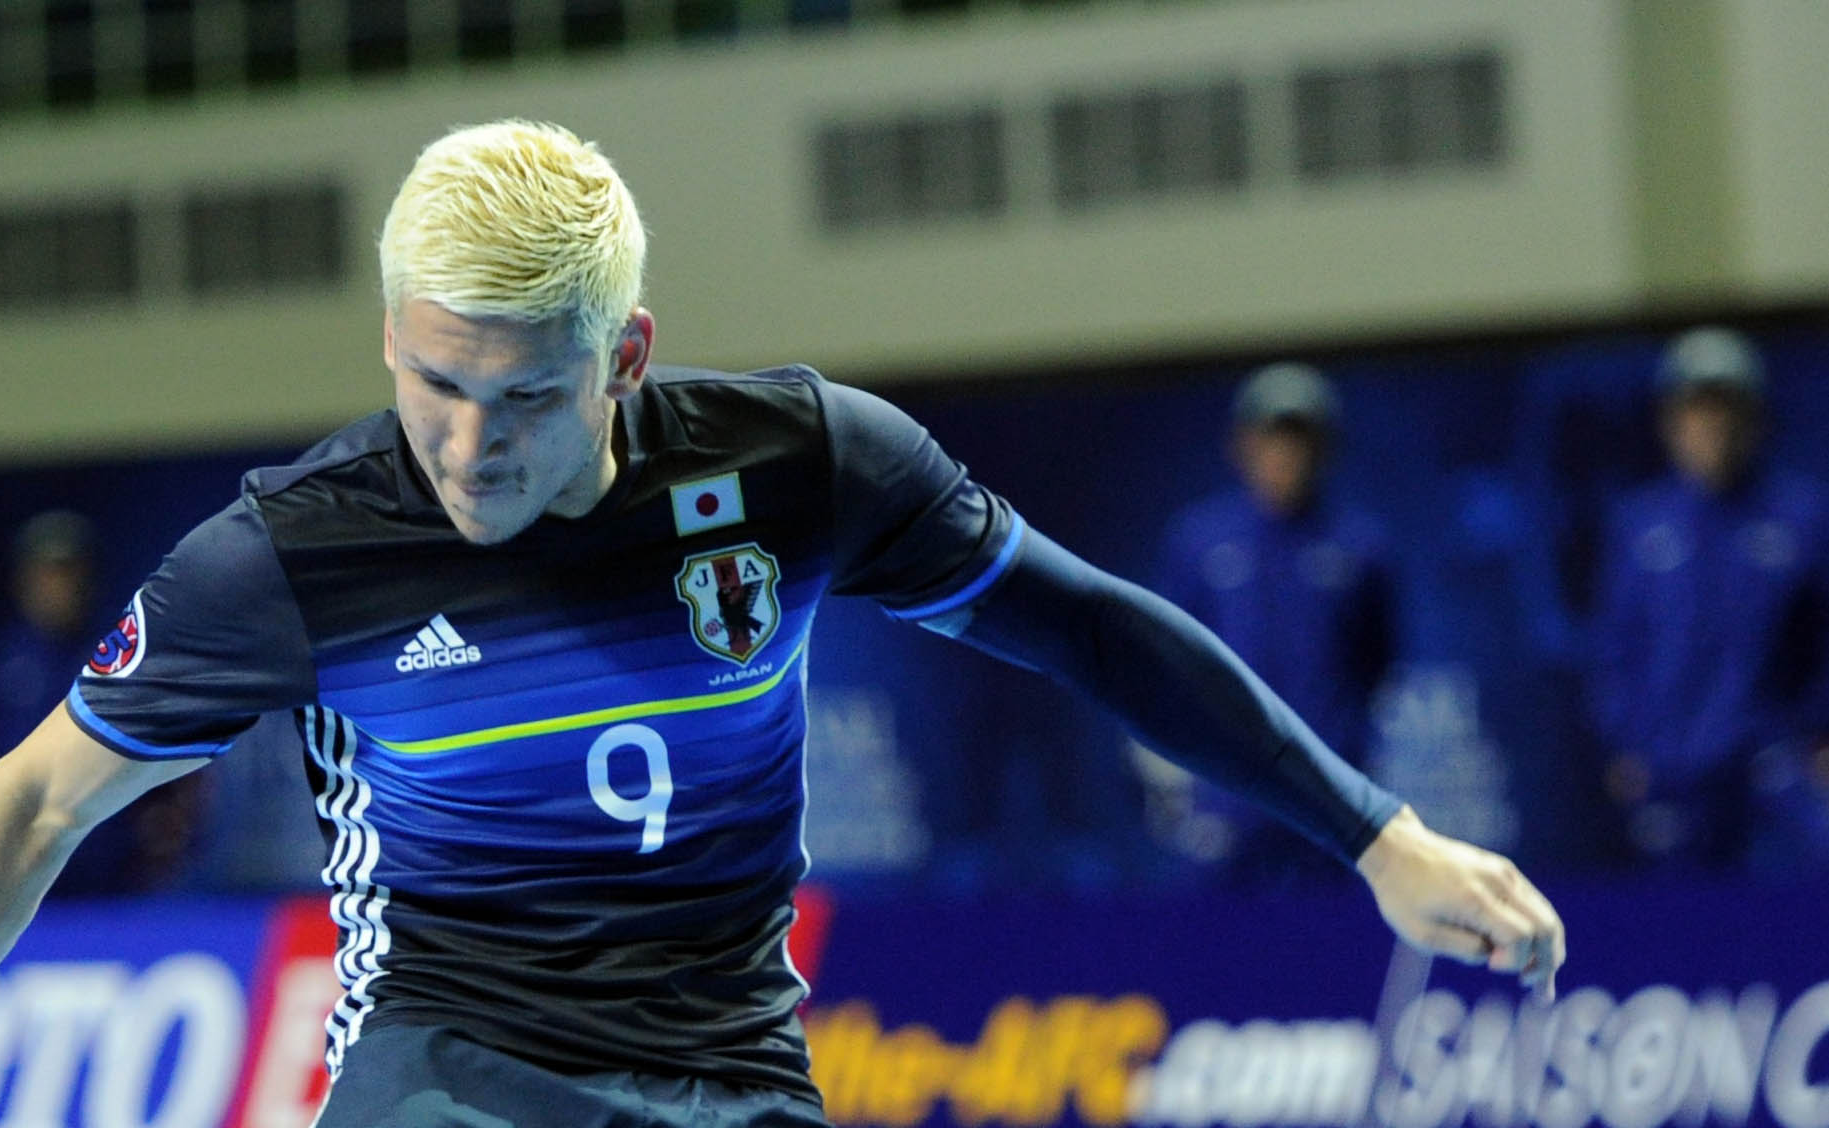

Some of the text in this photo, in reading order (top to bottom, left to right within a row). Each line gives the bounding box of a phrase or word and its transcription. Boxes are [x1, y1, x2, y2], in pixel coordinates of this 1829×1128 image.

[395, 645, 482, 673] adidas
[708, 661, 773, 686] JAPAN
[586, 723, 674, 854] 9
